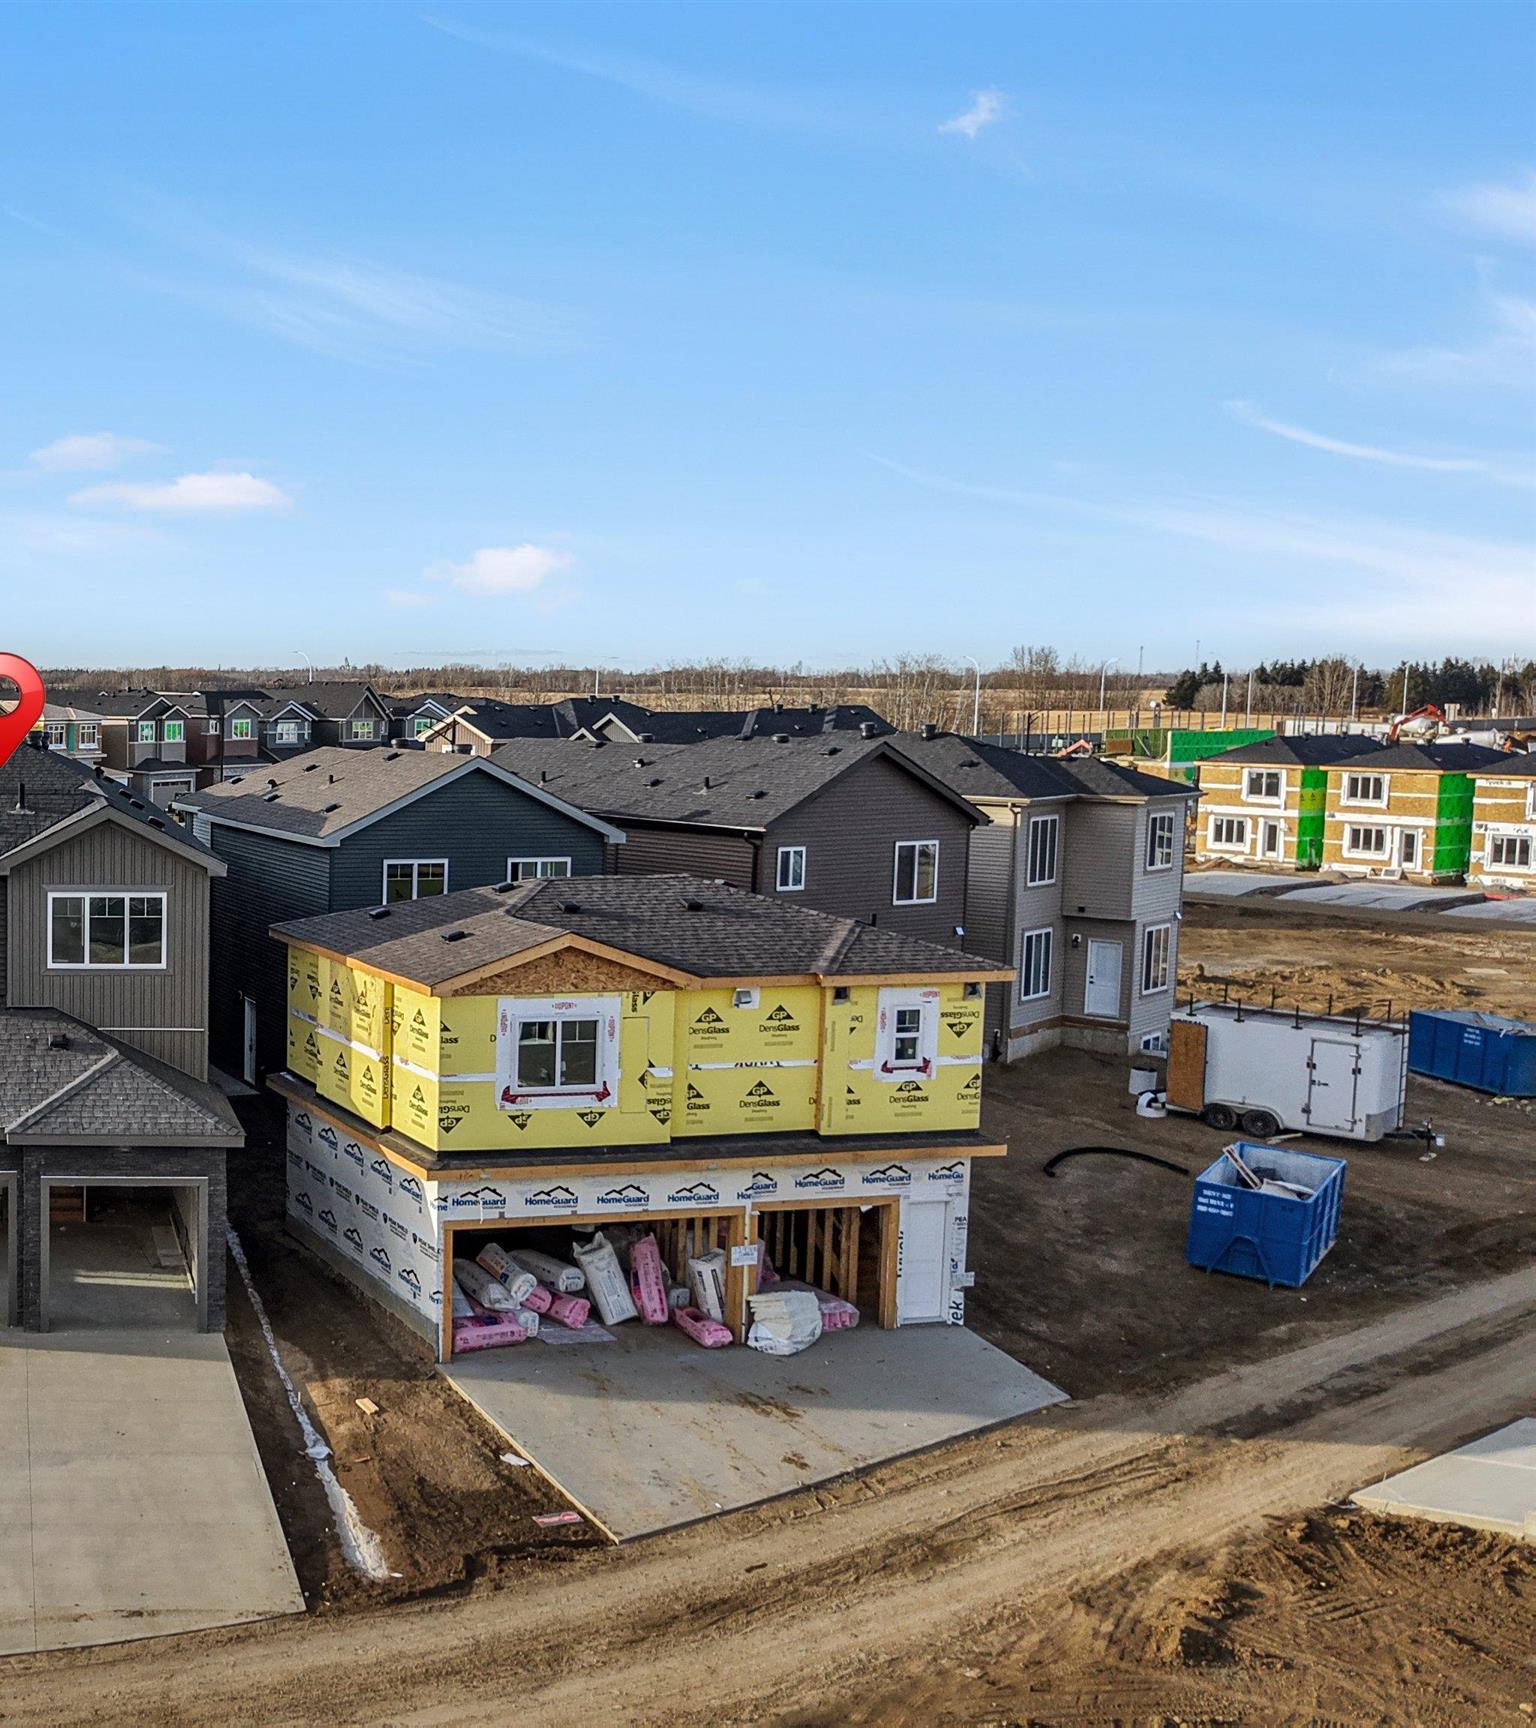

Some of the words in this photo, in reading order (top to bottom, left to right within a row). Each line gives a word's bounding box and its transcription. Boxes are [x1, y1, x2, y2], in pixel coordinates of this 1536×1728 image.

[701, 1013, 717, 1022] GP
[771, 1011, 787, 1019] GP
[941, 1011, 980, 1019] DensGlass
[410, 1025, 429, 1039] DensGlass
[688, 1026, 730, 1035] DensGlass
[759, 1024, 800, 1033] DensGlass
[952, 1023, 967, 1032] GP
[751, 1086, 767, 1095] GP
[901, 1082, 917, 1091] GP
[889, 1095, 929, 1103] DensGlass
[409, 1100, 428, 1117] DensGlass
[686, 1102, 710, 1110] Glass
[739, 1100, 781, 1108] DensGlass
[584, 1112, 599, 1121] GP
[370, 1163, 392, 1181] HomeGuard
[928, 1171, 964, 1181] HomeGu
[795, 1177, 845, 1188] HomeGuard
[862, 1173, 911, 1185] HomeGuard
[751, 1181, 777, 1190] Guard
[399, 1180, 423, 1201] HomeGuard
[452, 1197, 507, 1207] HomeGuard
[525, 1196, 578, 1206] HomeGuard
[596, 1194, 650, 1205] HomeGuard
[667, 1192, 720, 1203] HomeGuard
[398, 1269, 422, 1293] HomeGuard
